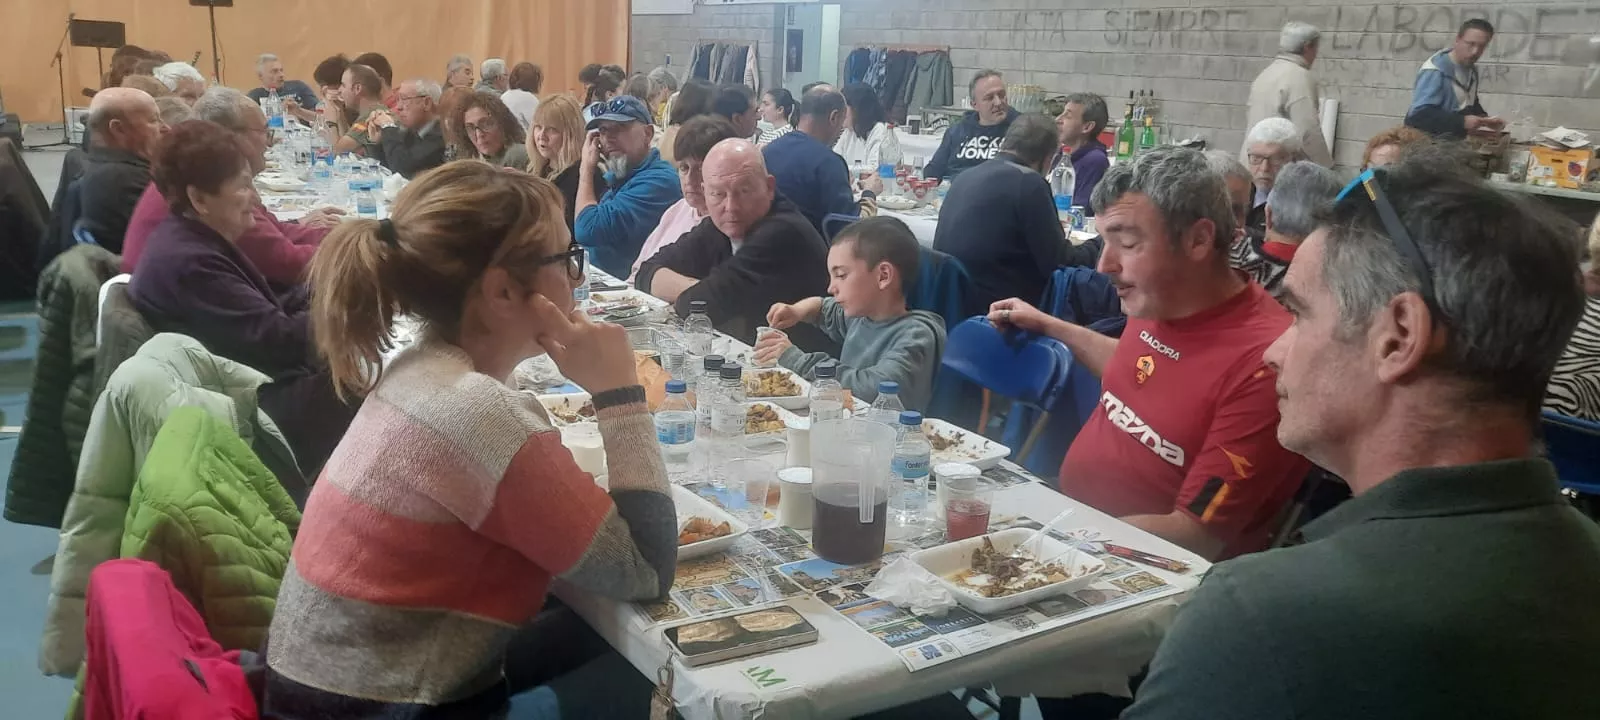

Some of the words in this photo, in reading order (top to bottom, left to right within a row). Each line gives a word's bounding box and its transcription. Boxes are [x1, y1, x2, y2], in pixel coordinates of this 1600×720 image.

[1333, 5, 1600, 61] LABODE
[956, 147, 1001, 160] JONE
[1139, 330, 1180, 361] DIADORA
[1100, 390, 1185, 467] mazda
